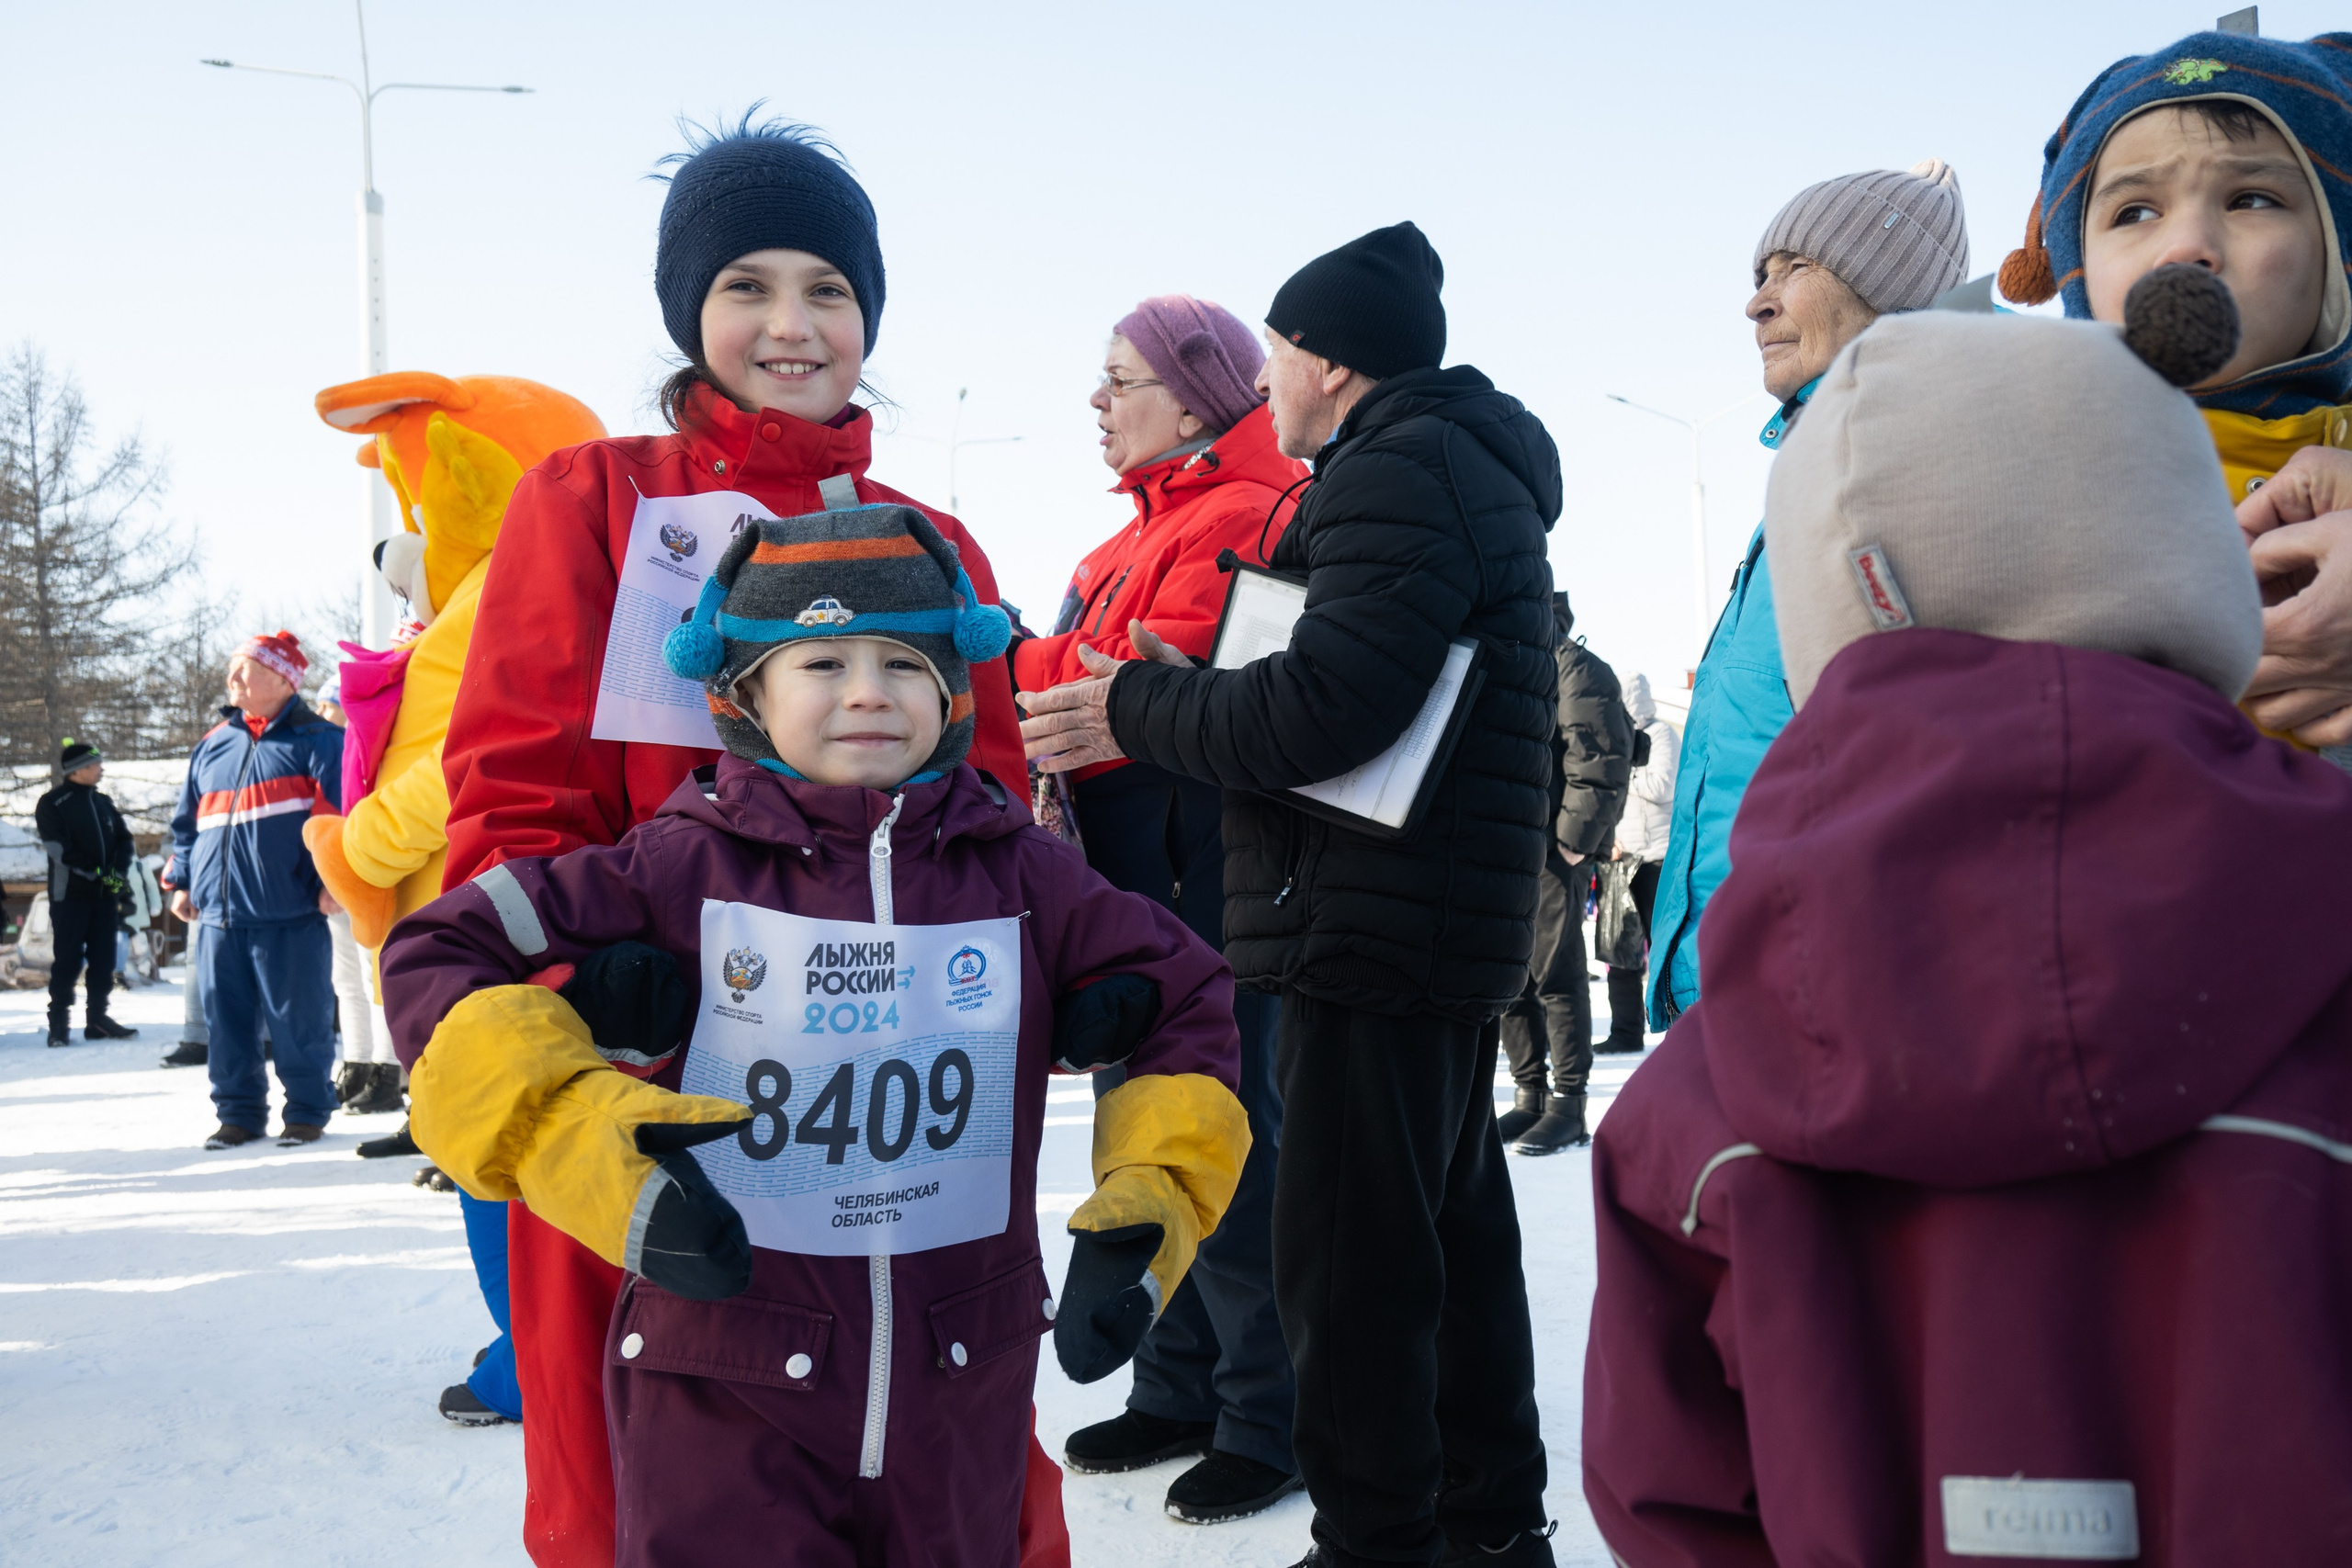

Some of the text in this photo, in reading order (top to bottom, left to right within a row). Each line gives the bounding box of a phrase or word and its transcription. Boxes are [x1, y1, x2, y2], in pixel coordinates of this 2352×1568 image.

[805, 941, 895, 967] ЛЫЖНЯ
[807, 967, 895, 995] РОССИИ
[951, 983, 987, 997] ФЕДЕРАЦИЯ
[945, 990, 992, 1008] ЛЫЖНЫХ ГОНОК
[958, 1001, 983, 1012] РОССИИ
[800, 999, 899, 1034] 2024
[738, 1048, 975, 1165] 8409
[834, 1181, 940, 1210] ЧЕЛЯБИНСКАЯ
[831, 1209, 902, 1228] ОБЛАСТЬ
